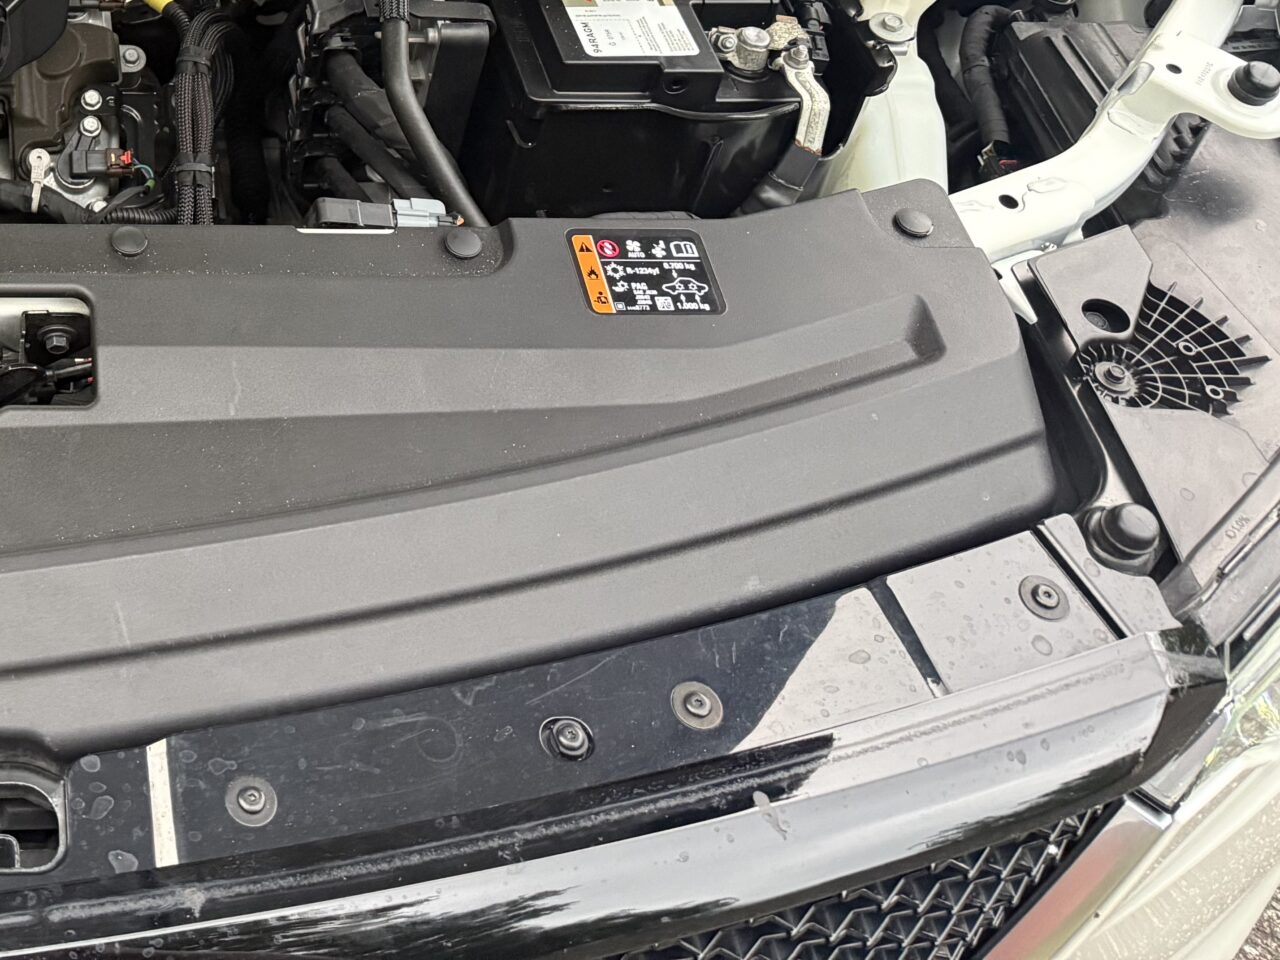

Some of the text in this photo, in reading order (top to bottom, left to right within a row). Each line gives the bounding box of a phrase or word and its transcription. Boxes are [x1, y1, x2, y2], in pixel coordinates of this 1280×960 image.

[580, 22, 602, 53] 94RAGM
[662, 262, 696, 271] 0.700 kg
[630, 282, 649, 290] PAG
[676, 302, 699, 310] 1.000
